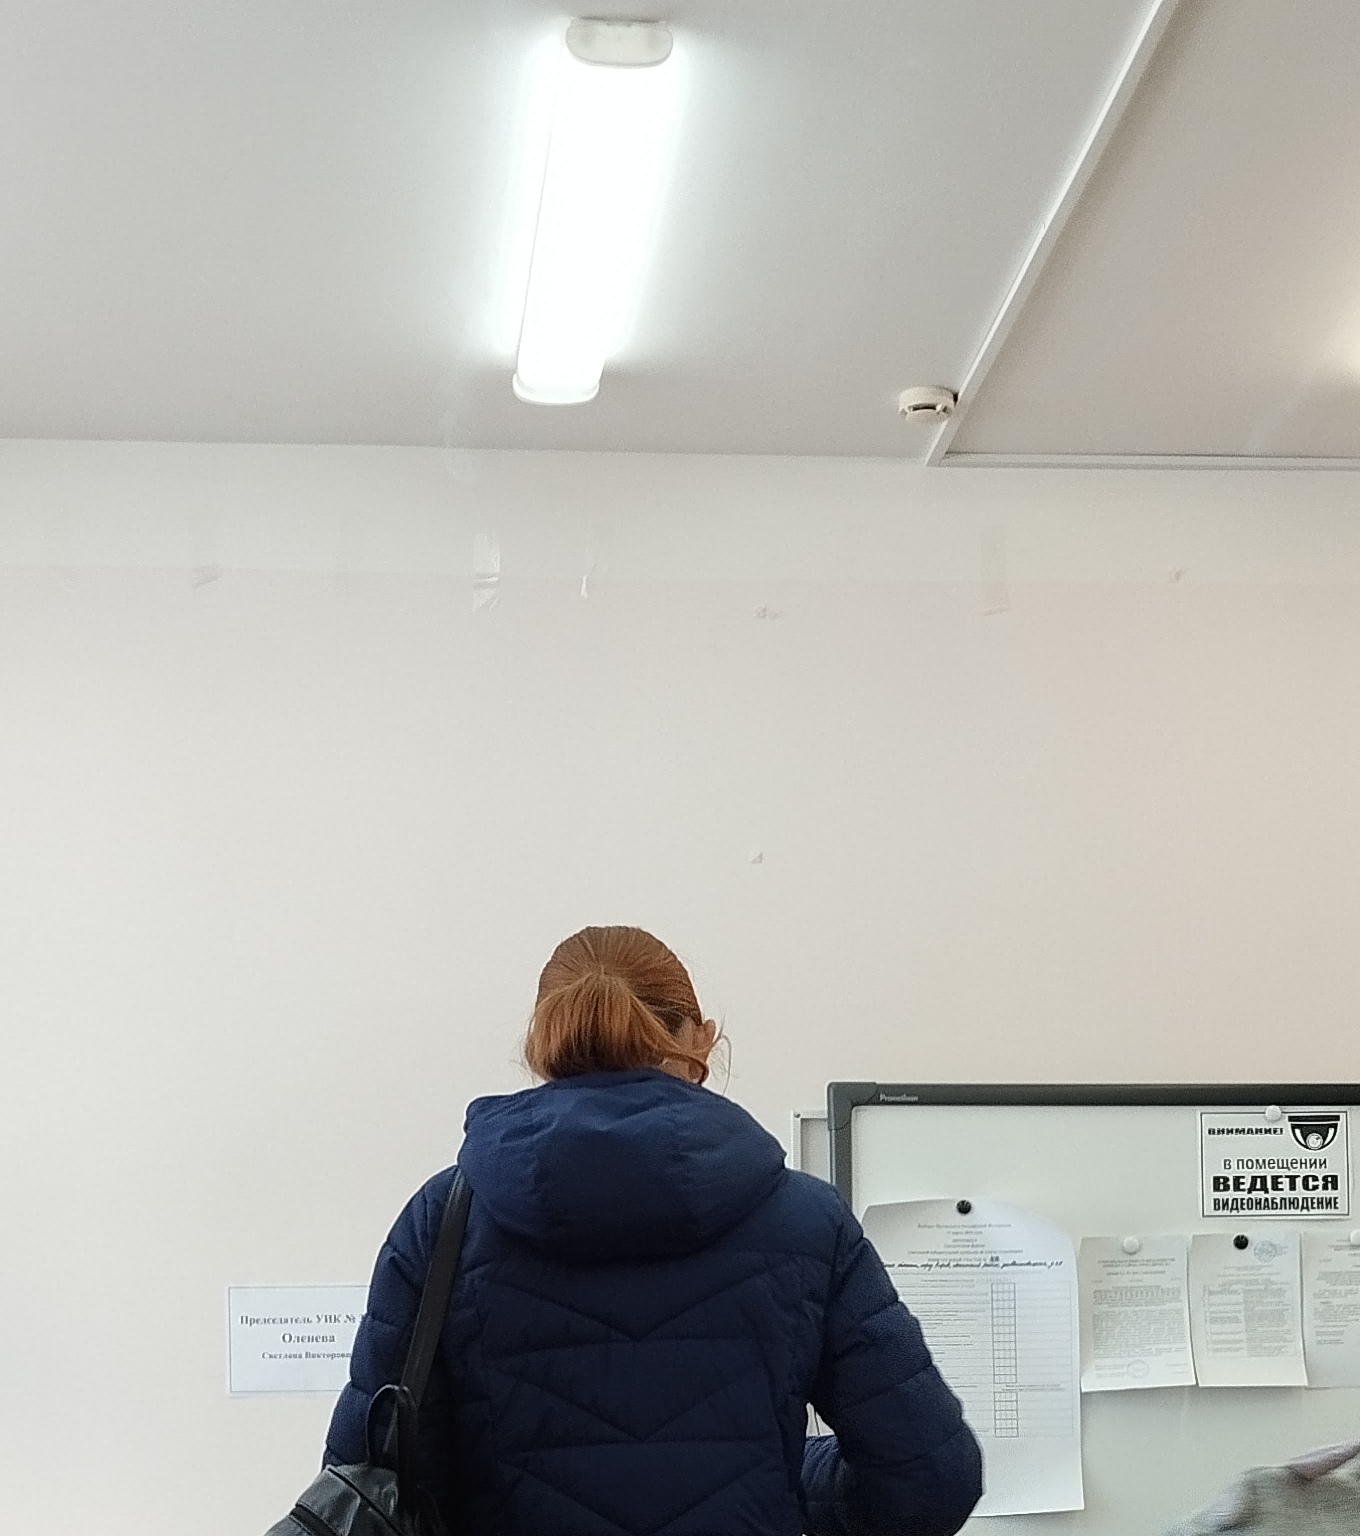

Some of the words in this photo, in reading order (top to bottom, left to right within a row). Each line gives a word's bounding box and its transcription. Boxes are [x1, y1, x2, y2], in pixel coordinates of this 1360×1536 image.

[1208, 1127, 1284, 1135] ВНИМАНИЕ!
[1237, 1158, 1327, 1171] помещении
[1213, 1175, 1339, 1194] ВЕДЕТСЯ
[1213, 1197, 1339, 1213] ВИДЕОНАБЛЮДЕНИЕ
[240, 1315, 313, 1327] Председатель
[316, 1313, 341, 1324] УИК
[281, 1332, 336, 1343] Оленева
[261, 1351, 303, 1360] Светлана
[305, 1351, 351, 1361] Викторовн
